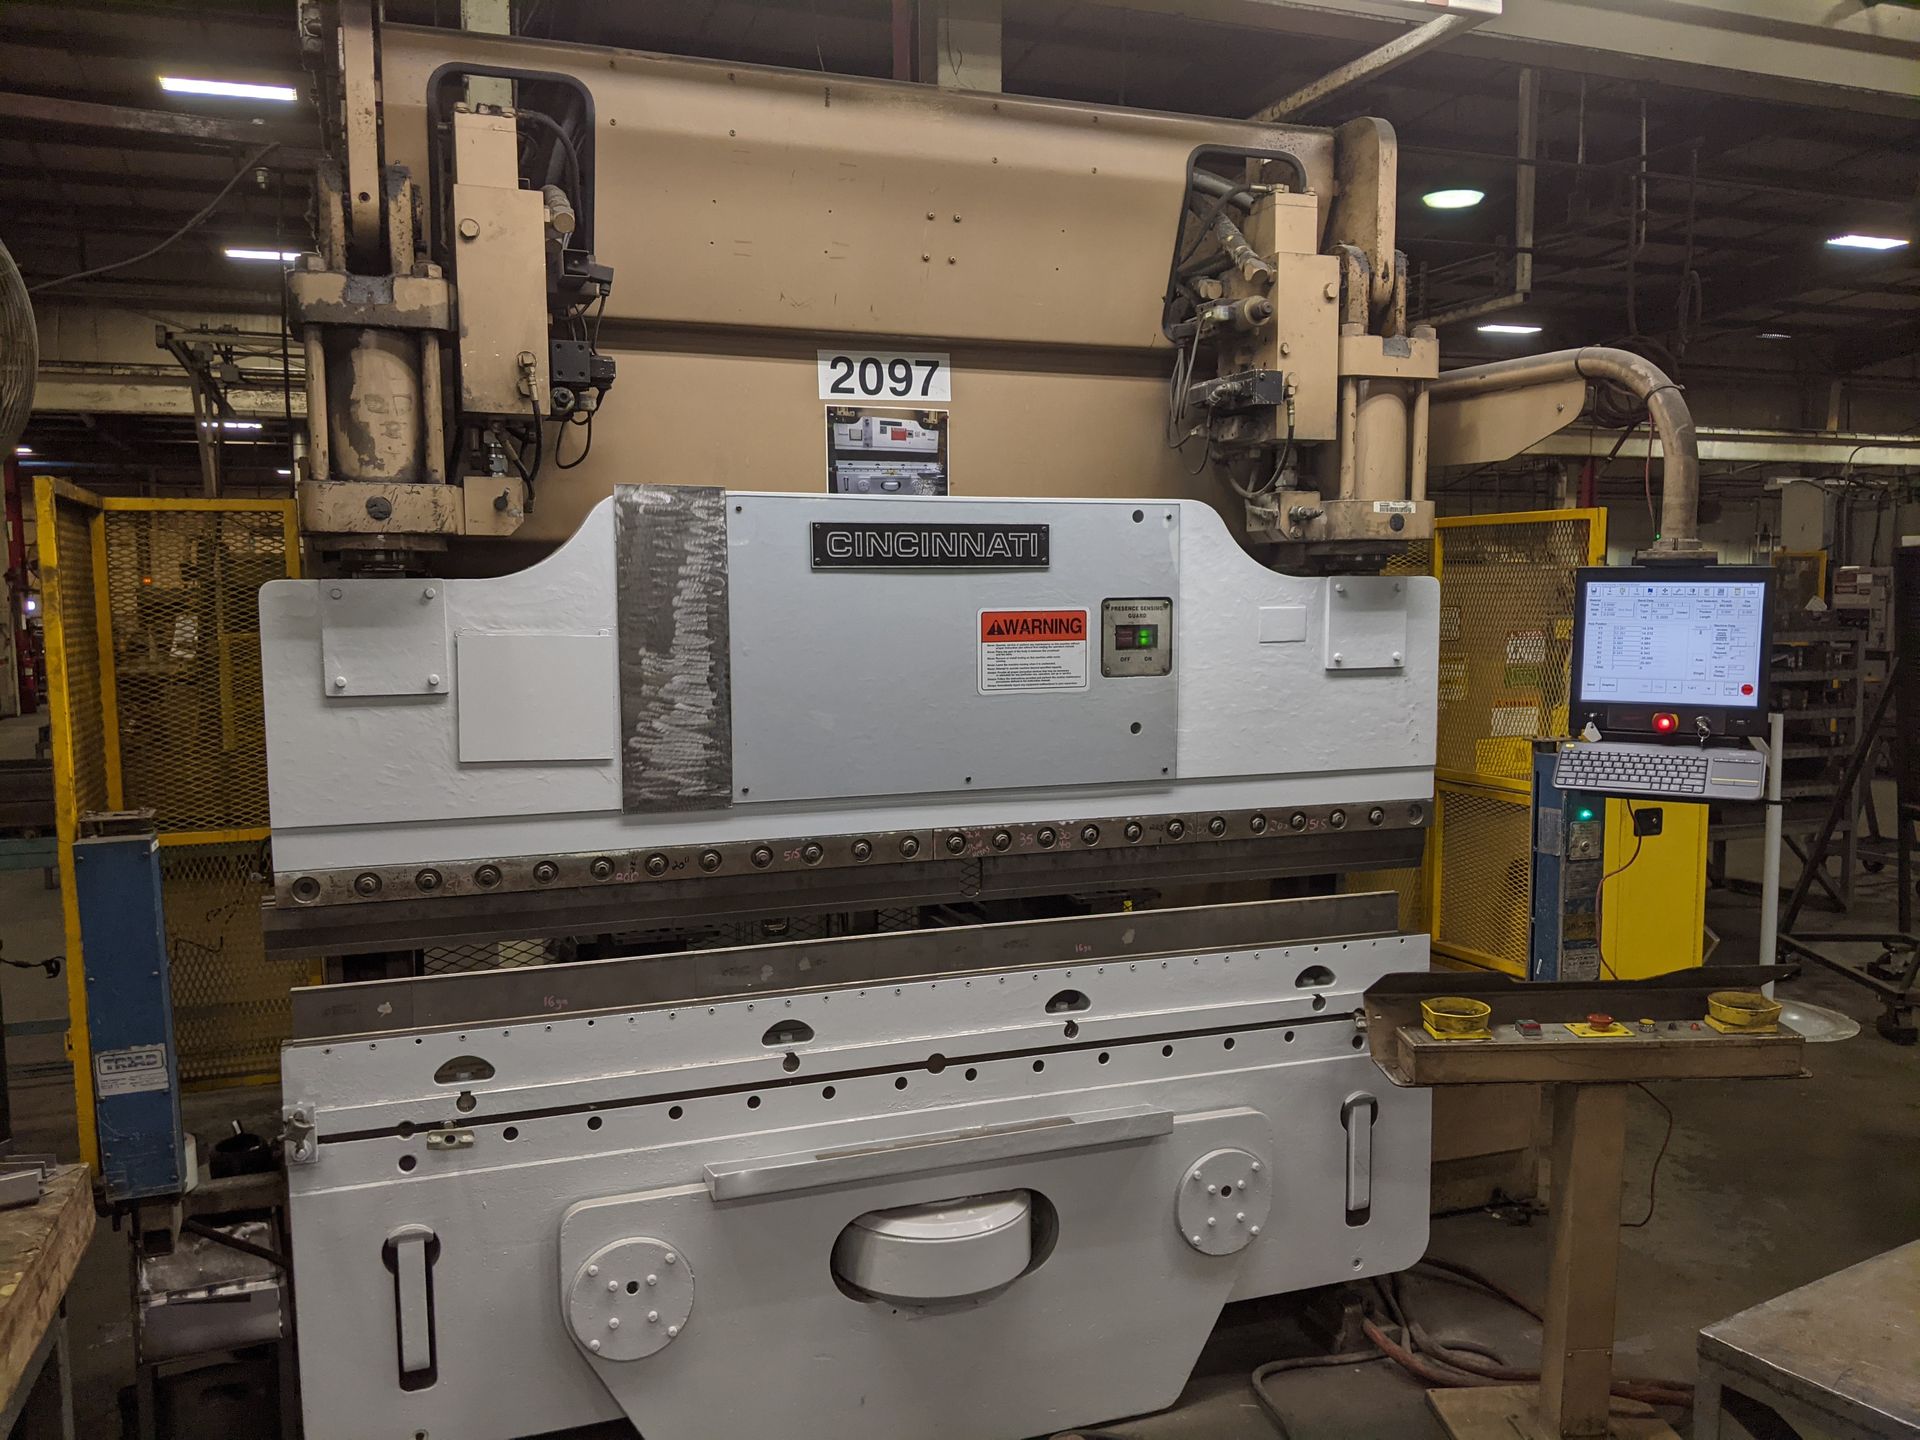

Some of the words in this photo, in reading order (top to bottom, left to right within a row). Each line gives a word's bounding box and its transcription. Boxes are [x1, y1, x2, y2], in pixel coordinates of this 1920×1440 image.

[829, 355, 940, 397] 2097
[826, 531, 1038, 558] CINCINNATI
[1003, 617, 1083, 635] WARNING
[103, 1053, 158, 1071] TRIAD
